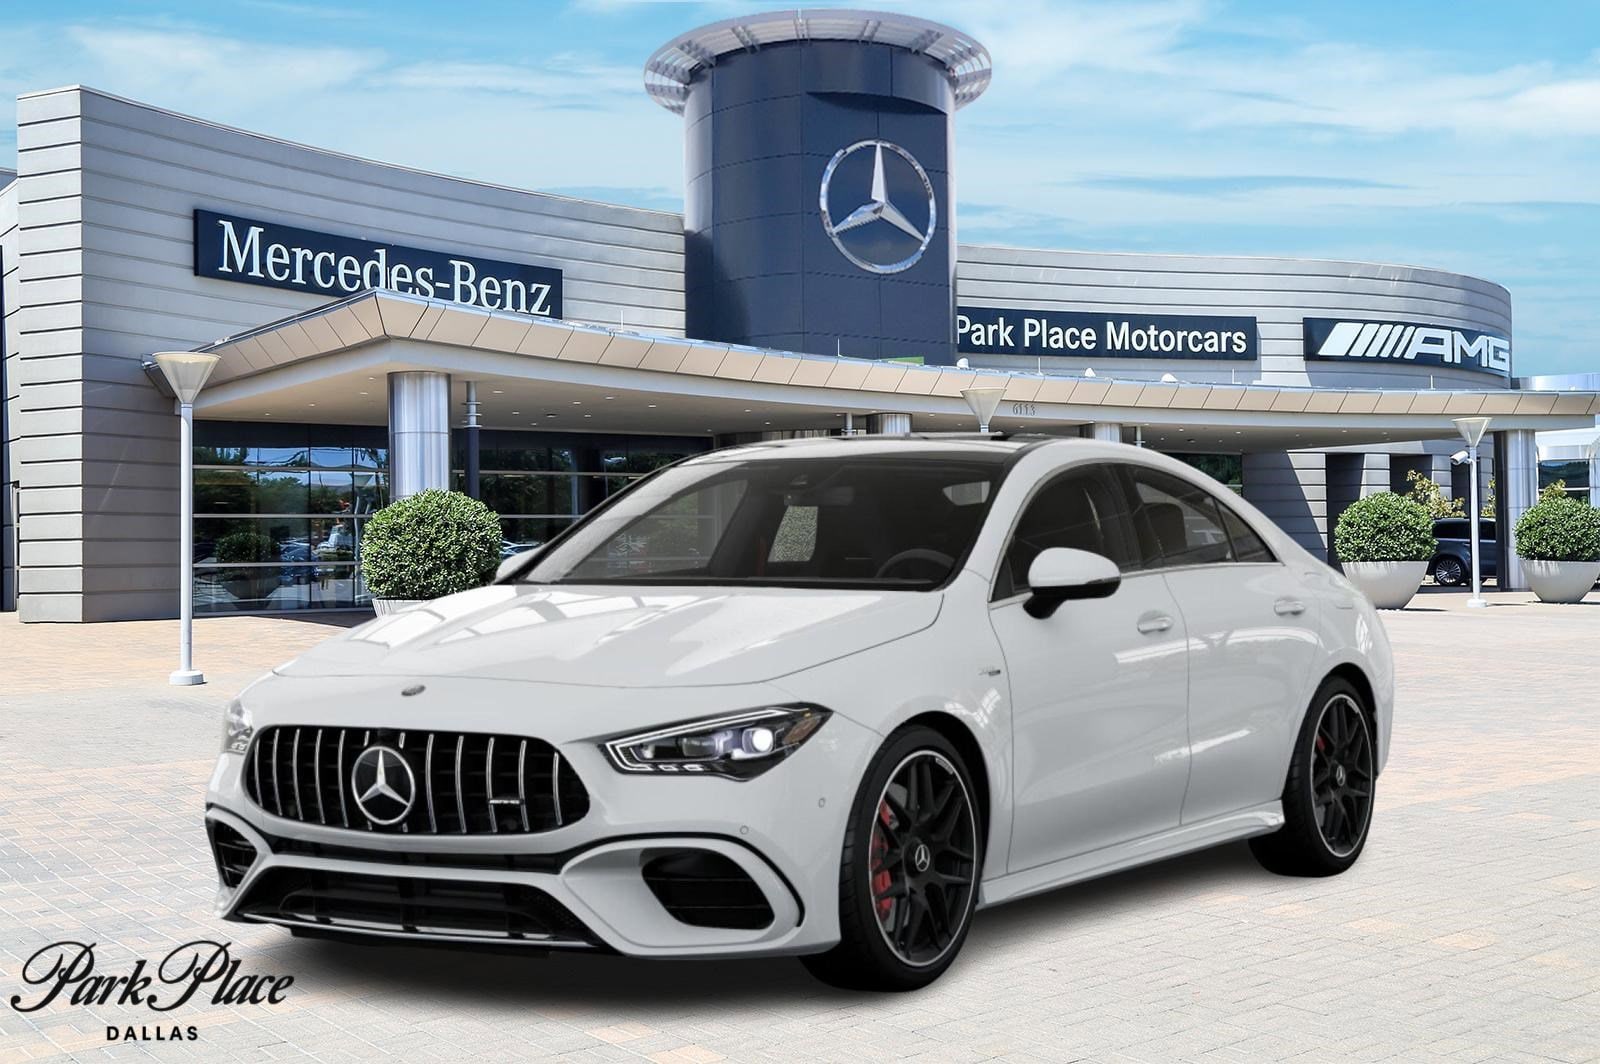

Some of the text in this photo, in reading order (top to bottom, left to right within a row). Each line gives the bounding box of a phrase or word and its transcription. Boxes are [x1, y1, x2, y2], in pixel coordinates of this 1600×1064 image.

[217, 219, 552, 316] Mercedes-Benz
[957, 315, 1248, 354] Park Place Motorcars
[1403, 326, 1510, 371] AMG
